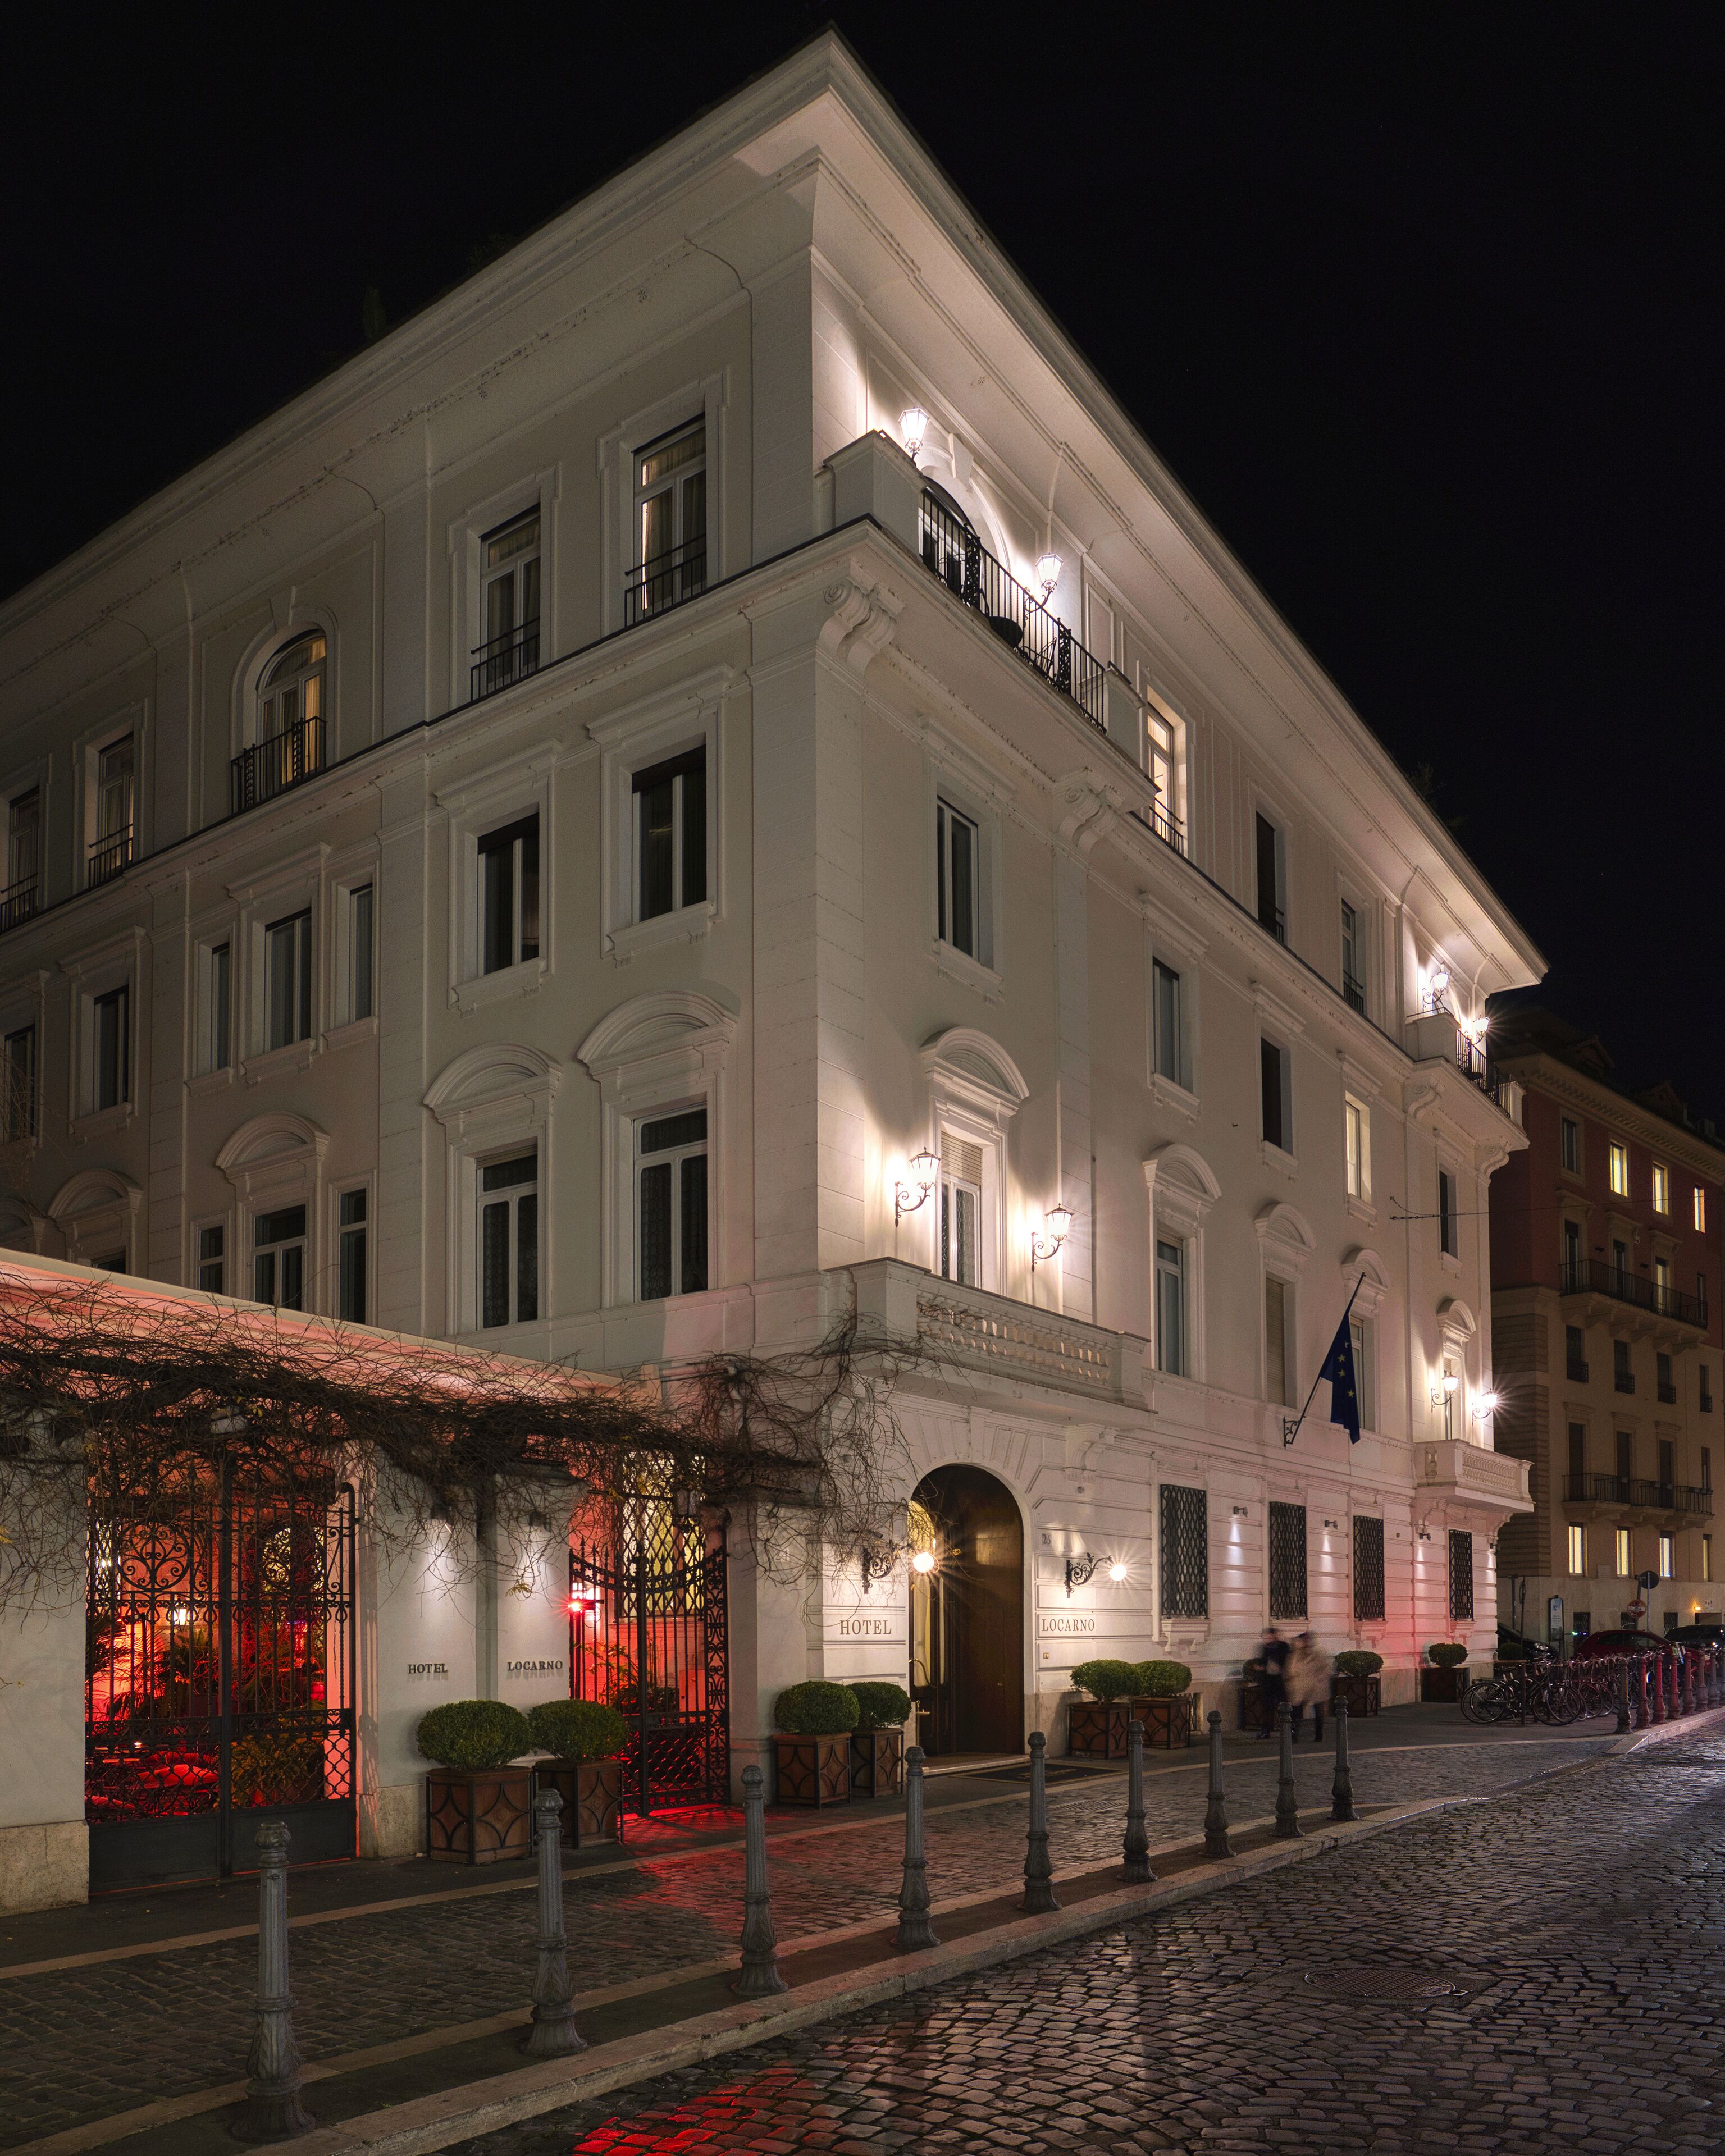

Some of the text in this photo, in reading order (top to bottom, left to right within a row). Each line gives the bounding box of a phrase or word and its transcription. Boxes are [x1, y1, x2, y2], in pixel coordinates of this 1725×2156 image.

[839, 1619, 892, 1635] HOTEL
[1042, 1619, 1095, 1632] LOCARNO
[408, 1663, 449, 1674] HOTEL
[507, 1660, 563, 1671] LOCARNO
